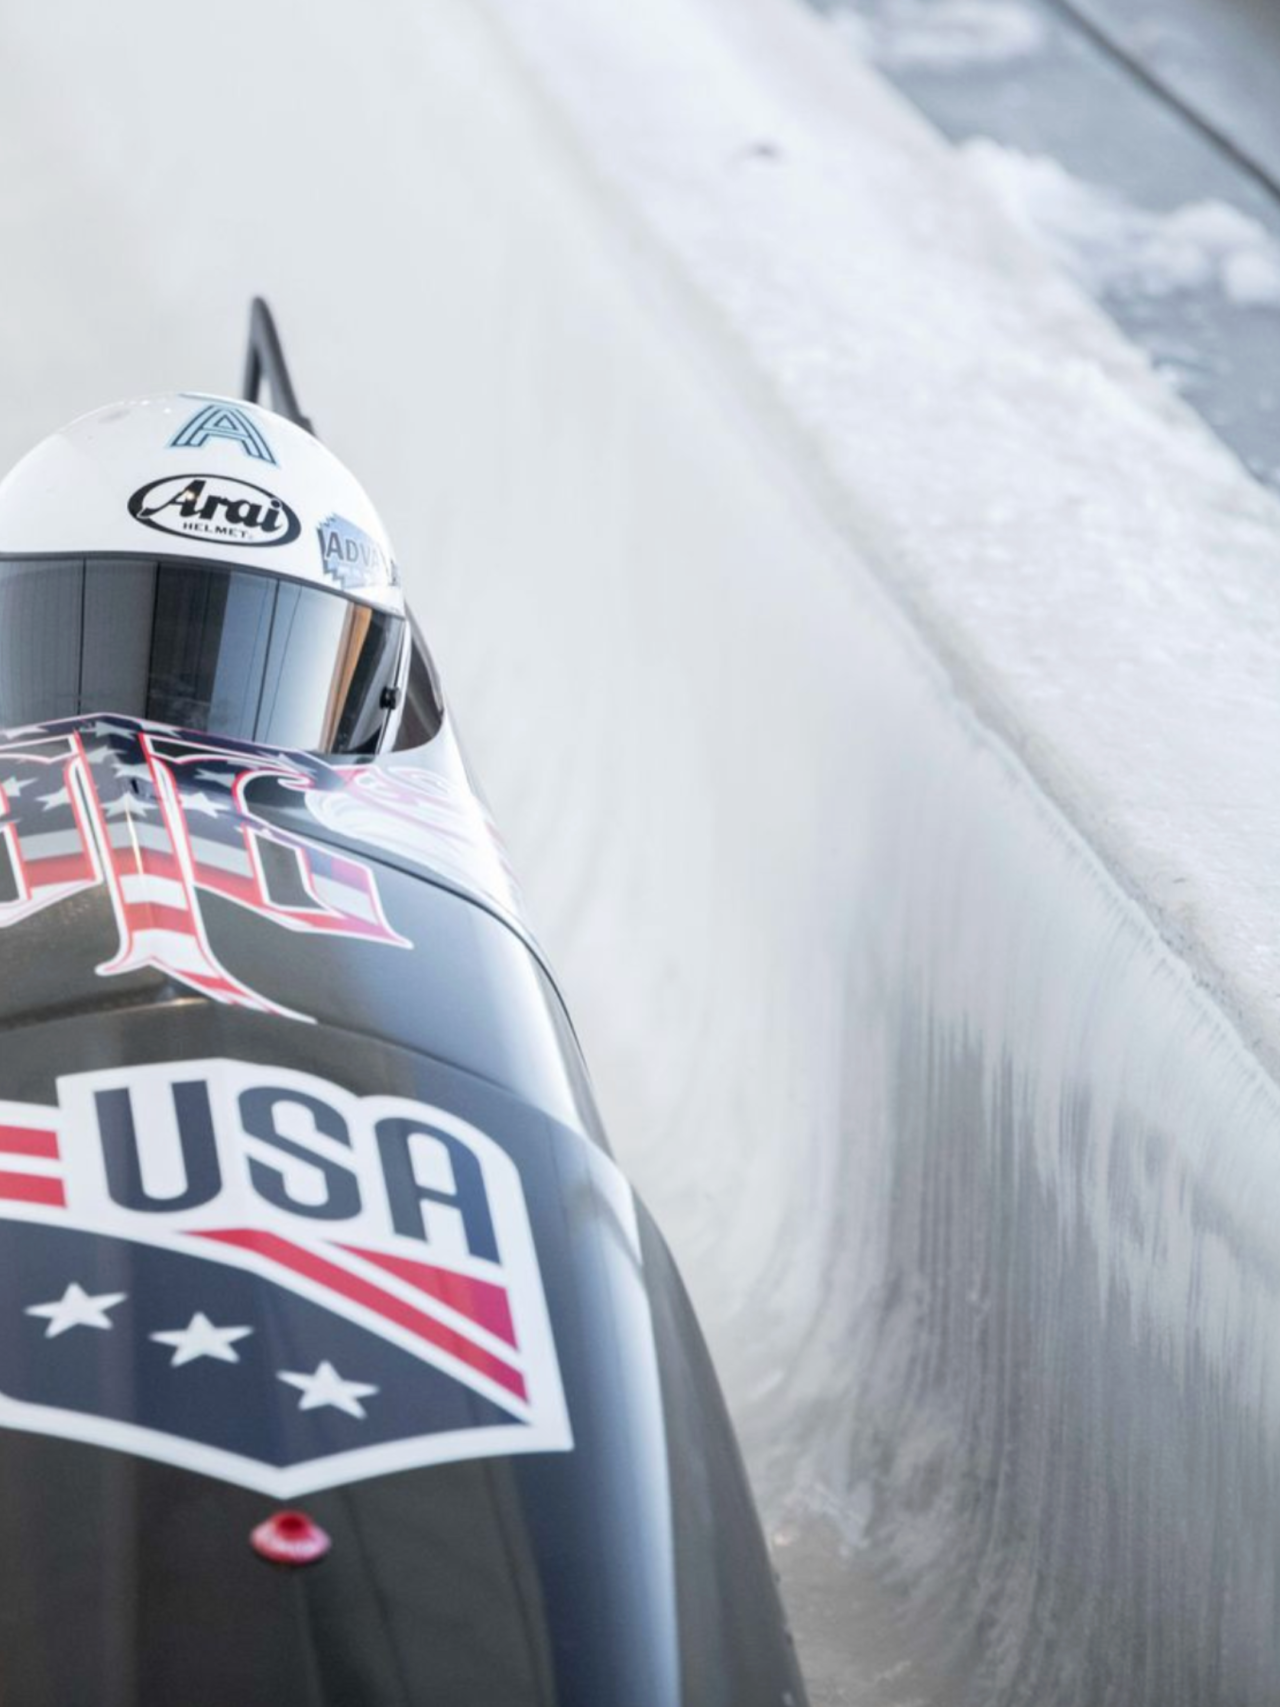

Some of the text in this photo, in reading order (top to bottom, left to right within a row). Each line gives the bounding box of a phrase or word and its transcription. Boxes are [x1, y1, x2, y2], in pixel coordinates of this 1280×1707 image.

[169, 401, 277, 466] A
[136, 479, 284, 533] Arai
[182, 521, 248, 538] HELMET
[93, 1079, 502, 1266] USA
